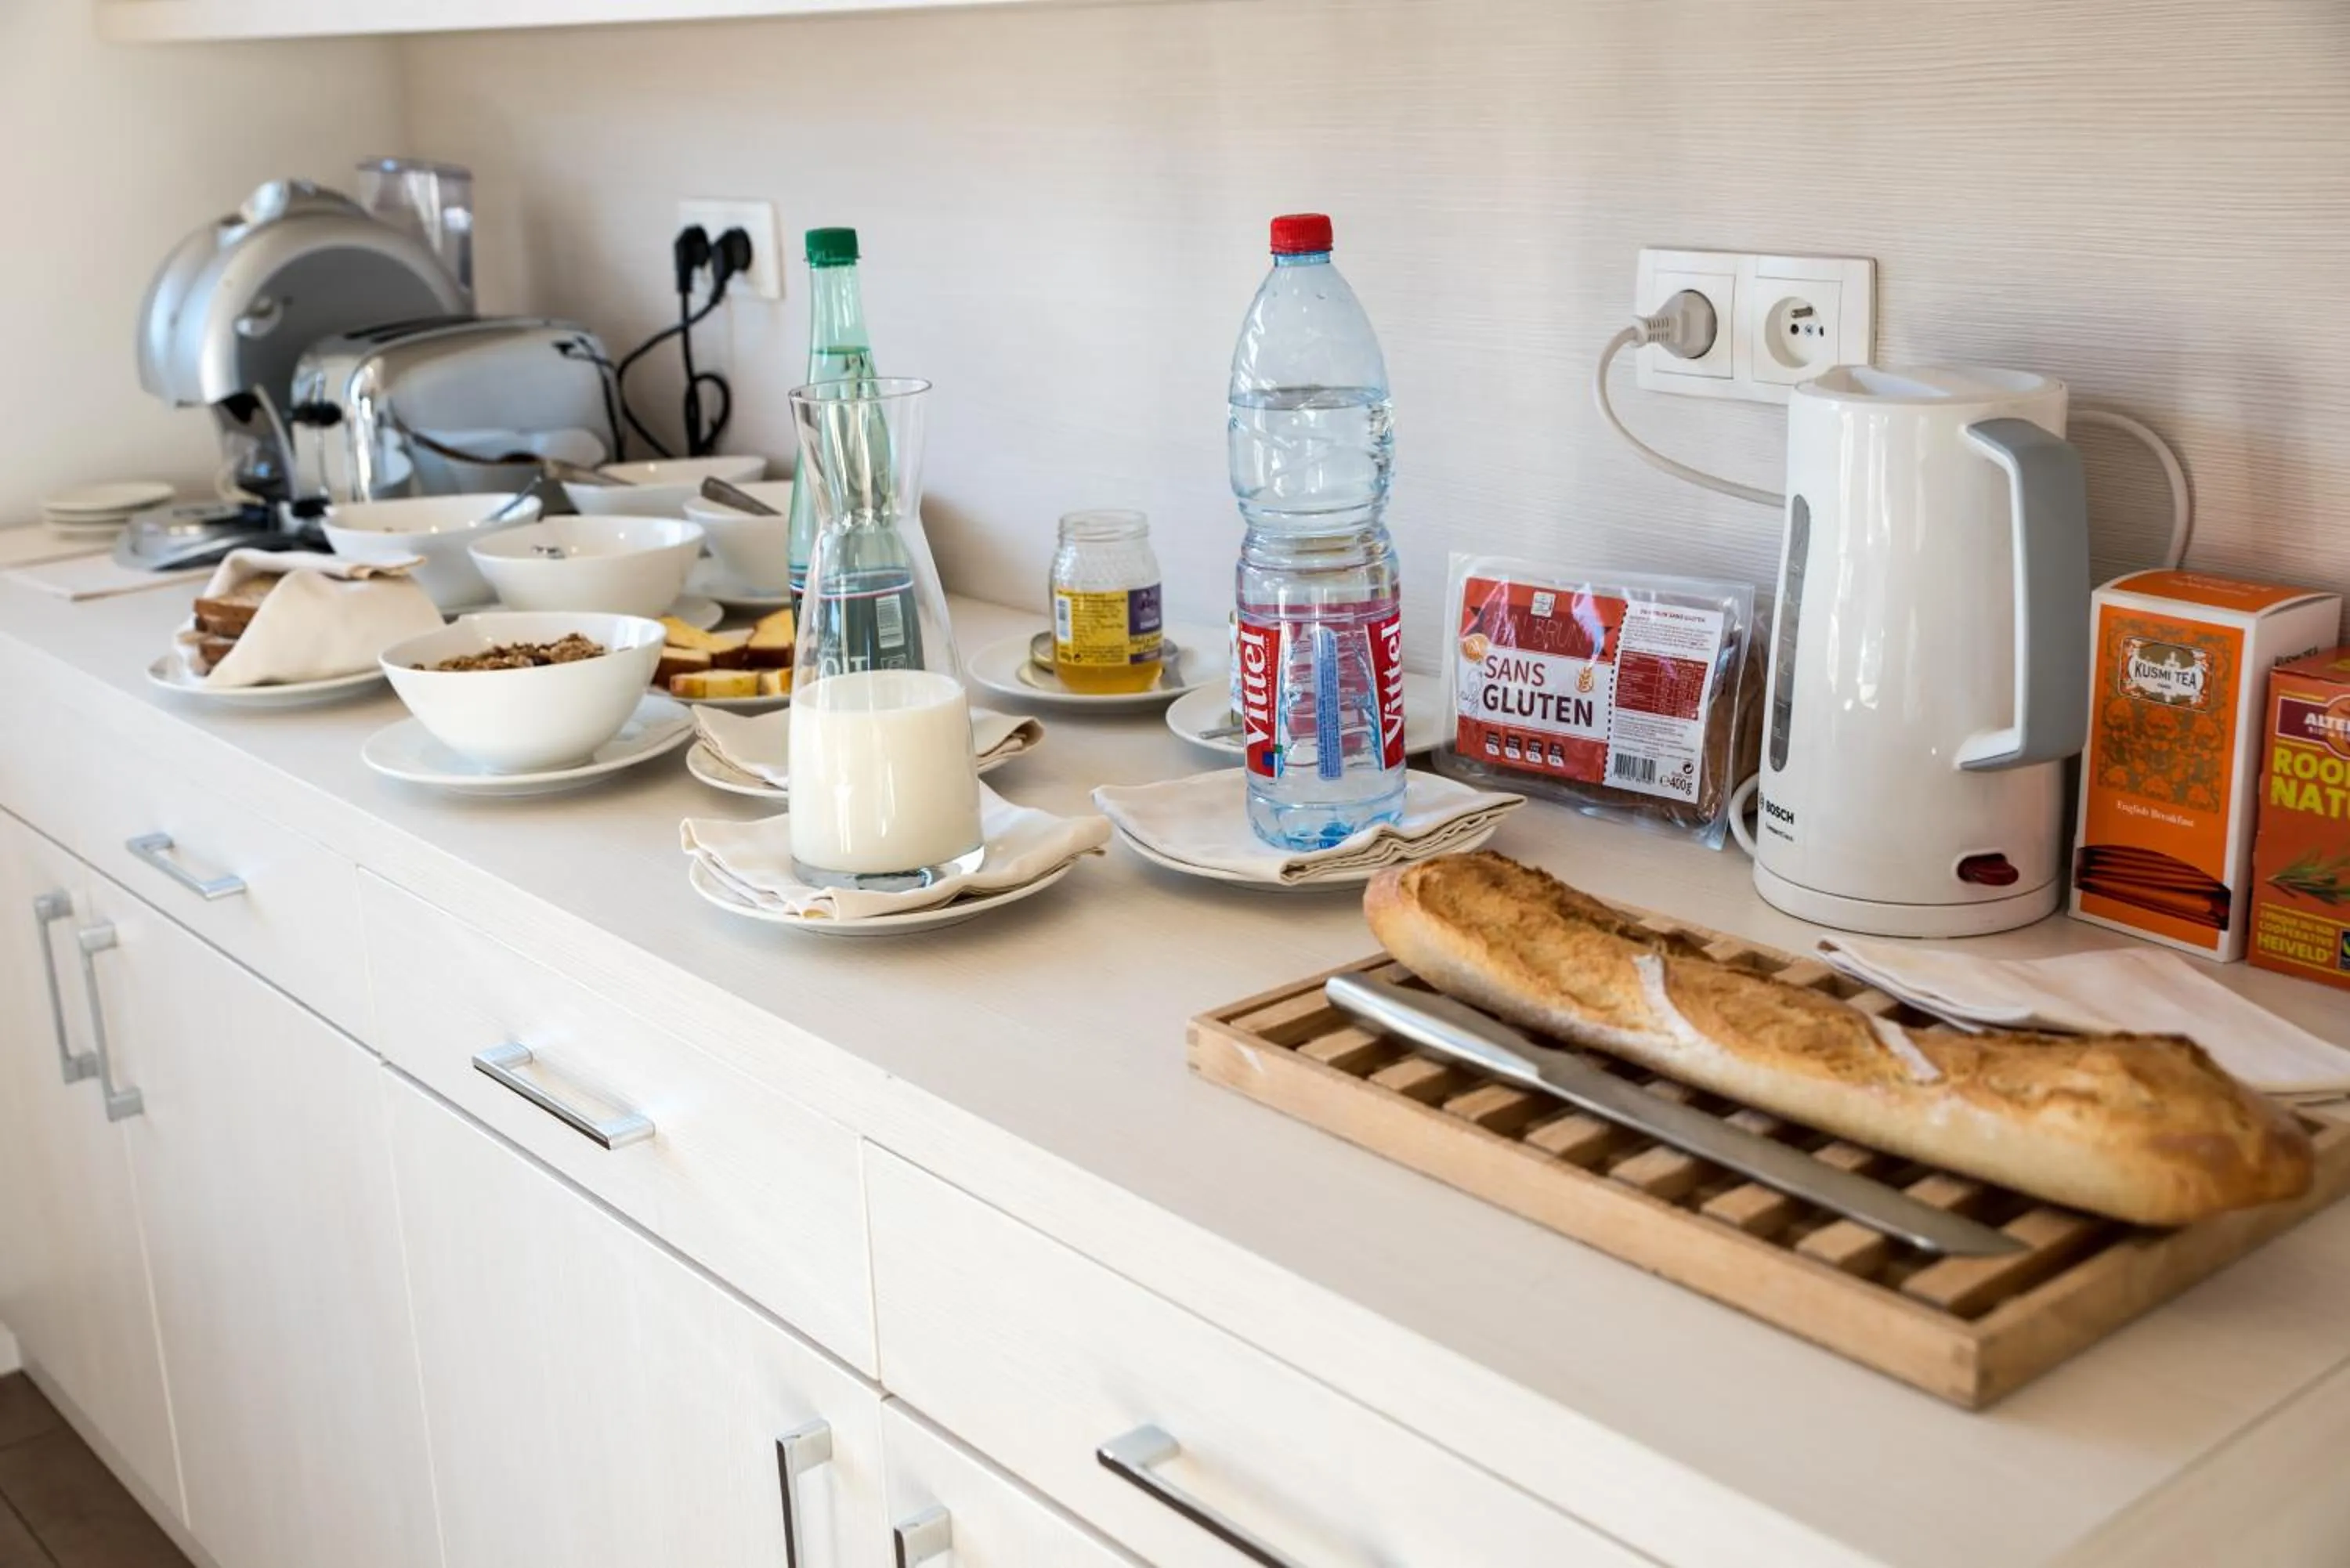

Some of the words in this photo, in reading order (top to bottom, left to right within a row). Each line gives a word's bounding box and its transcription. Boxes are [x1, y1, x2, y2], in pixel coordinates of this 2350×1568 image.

[1240, 630, 1270, 747] Vittel
[1381, 621, 1403, 746] Vittel
[1484, 654, 1546, 687] SANS
[2134, 659, 2171, 681] KUSMI
[2175, 670, 2197, 690] TEA
[1483, 683, 1593, 728] GLUTEN
[2272, 746, 2350, 789] ROO
[1766, 799, 1795, 825] BOSCH
[2117, 800, 2150, 817] English
[2150, 808, 2194, 828] Breakfast
[2271, 775, 2350, 819] NAT
